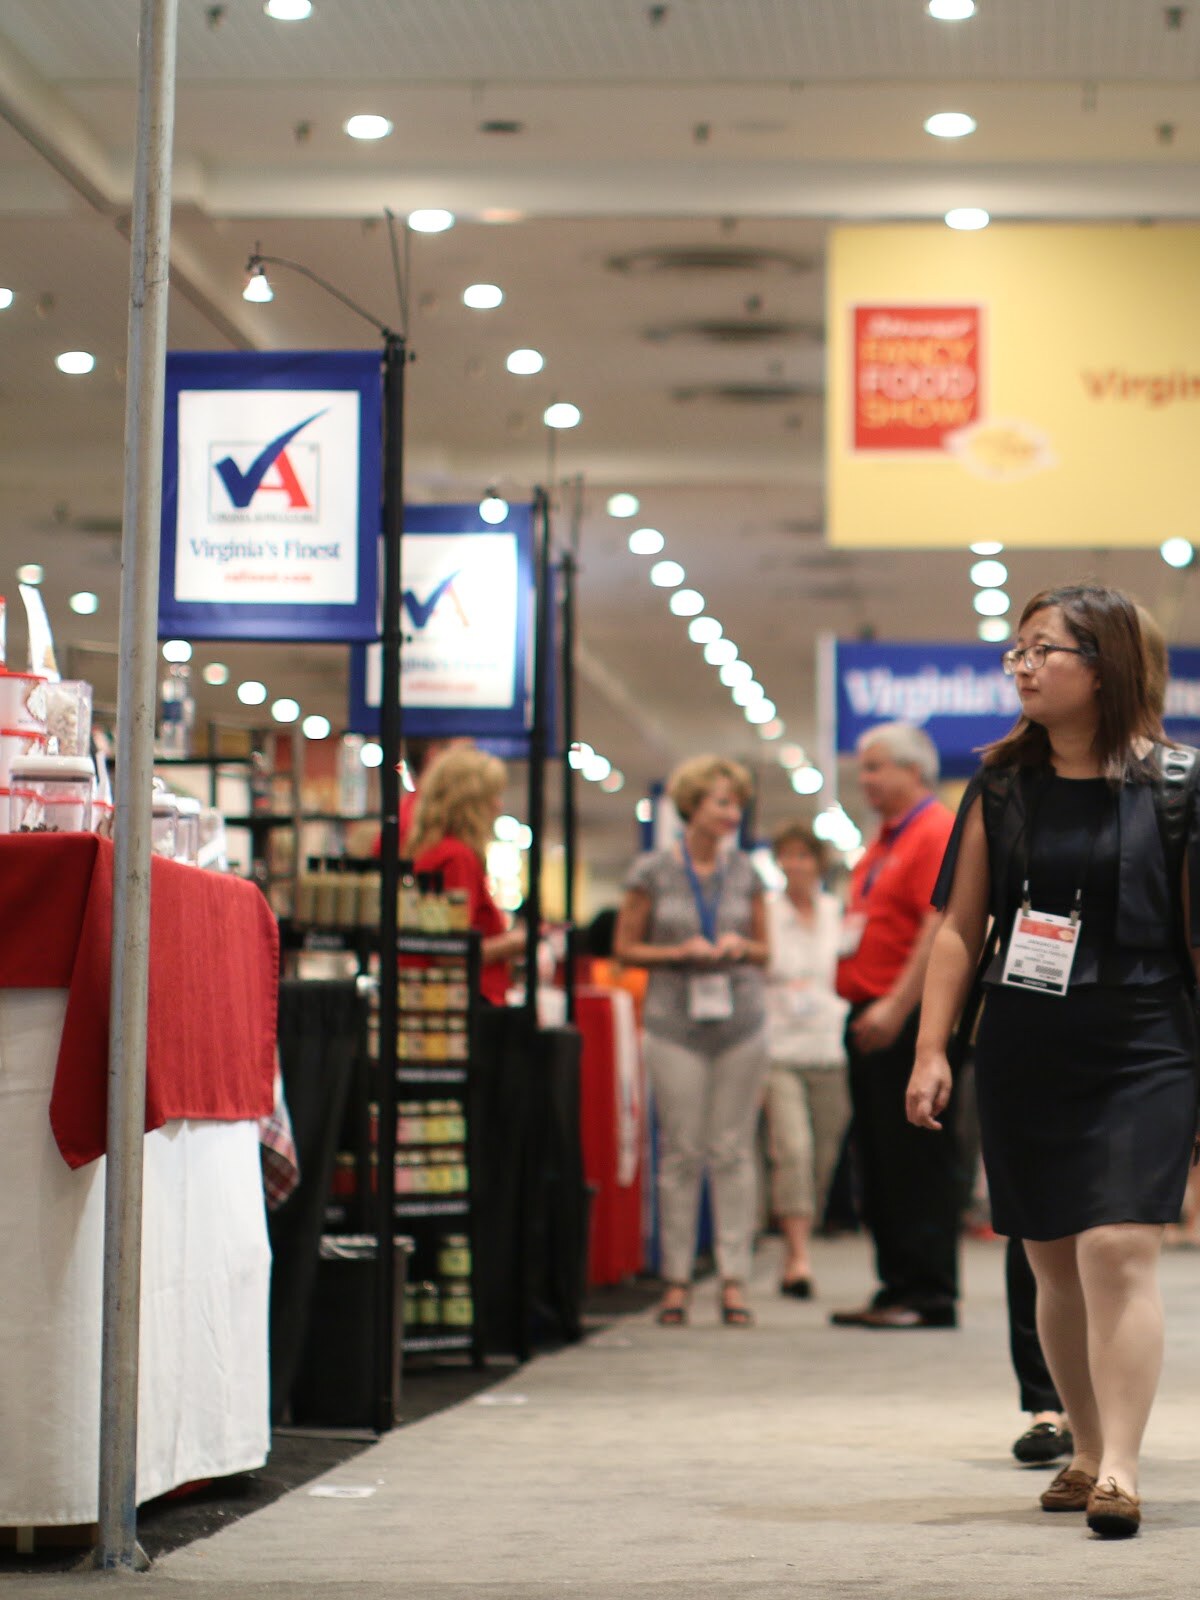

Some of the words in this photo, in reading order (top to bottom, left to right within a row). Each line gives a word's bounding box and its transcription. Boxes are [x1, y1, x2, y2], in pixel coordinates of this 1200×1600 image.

[860, 364, 975, 400] FOOD
[189, 537, 279, 564] Virginia's
[284, 539, 341, 560] Finest
[845, 666, 1022, 727] Virginia's
